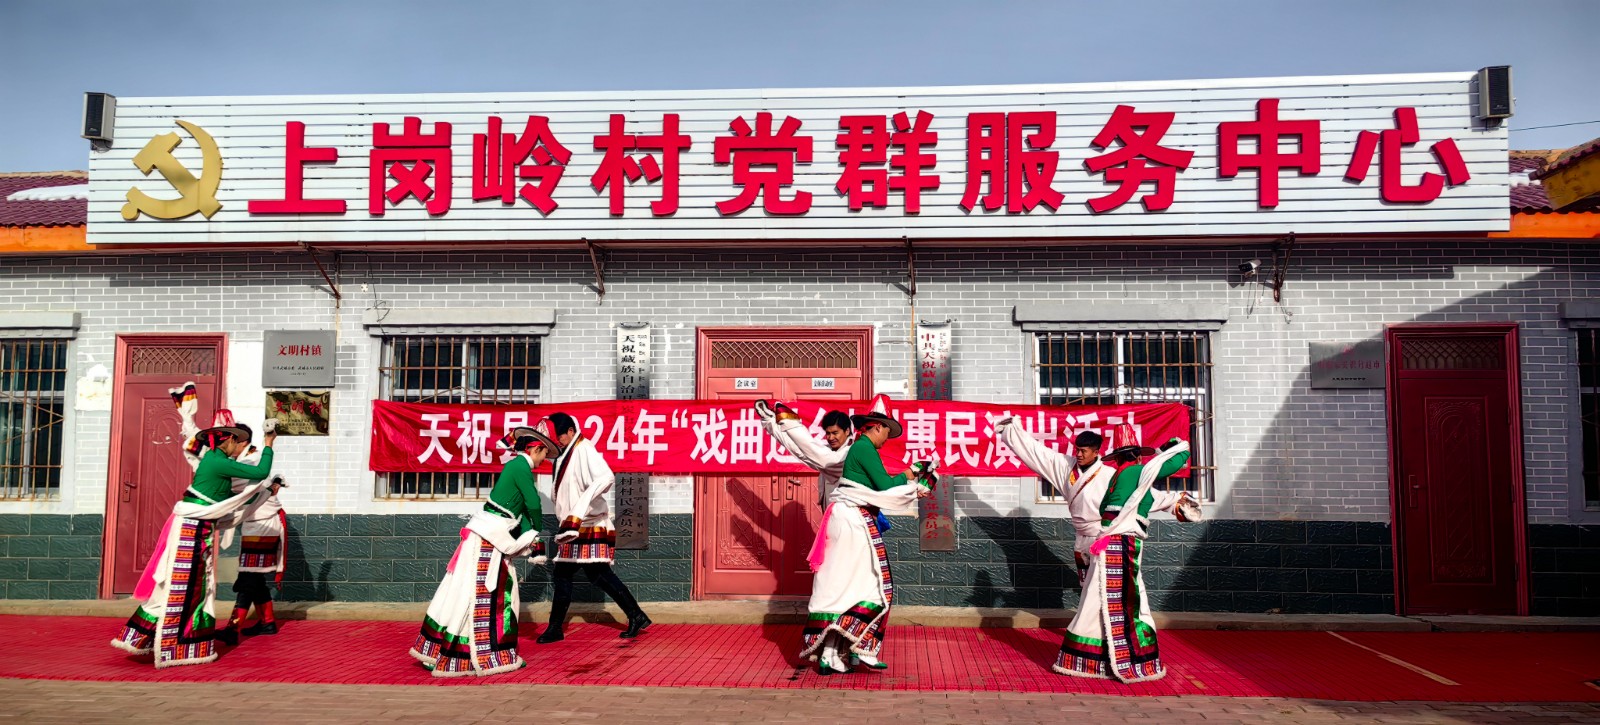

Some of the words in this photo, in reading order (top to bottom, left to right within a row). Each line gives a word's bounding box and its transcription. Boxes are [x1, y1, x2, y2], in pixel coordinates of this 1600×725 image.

[248, 98, 1470, 216] 上岗岭村党群服务中心
[277, 344, 323, 357] 文明村镇
[274, 399, 323, 415] 文明村
